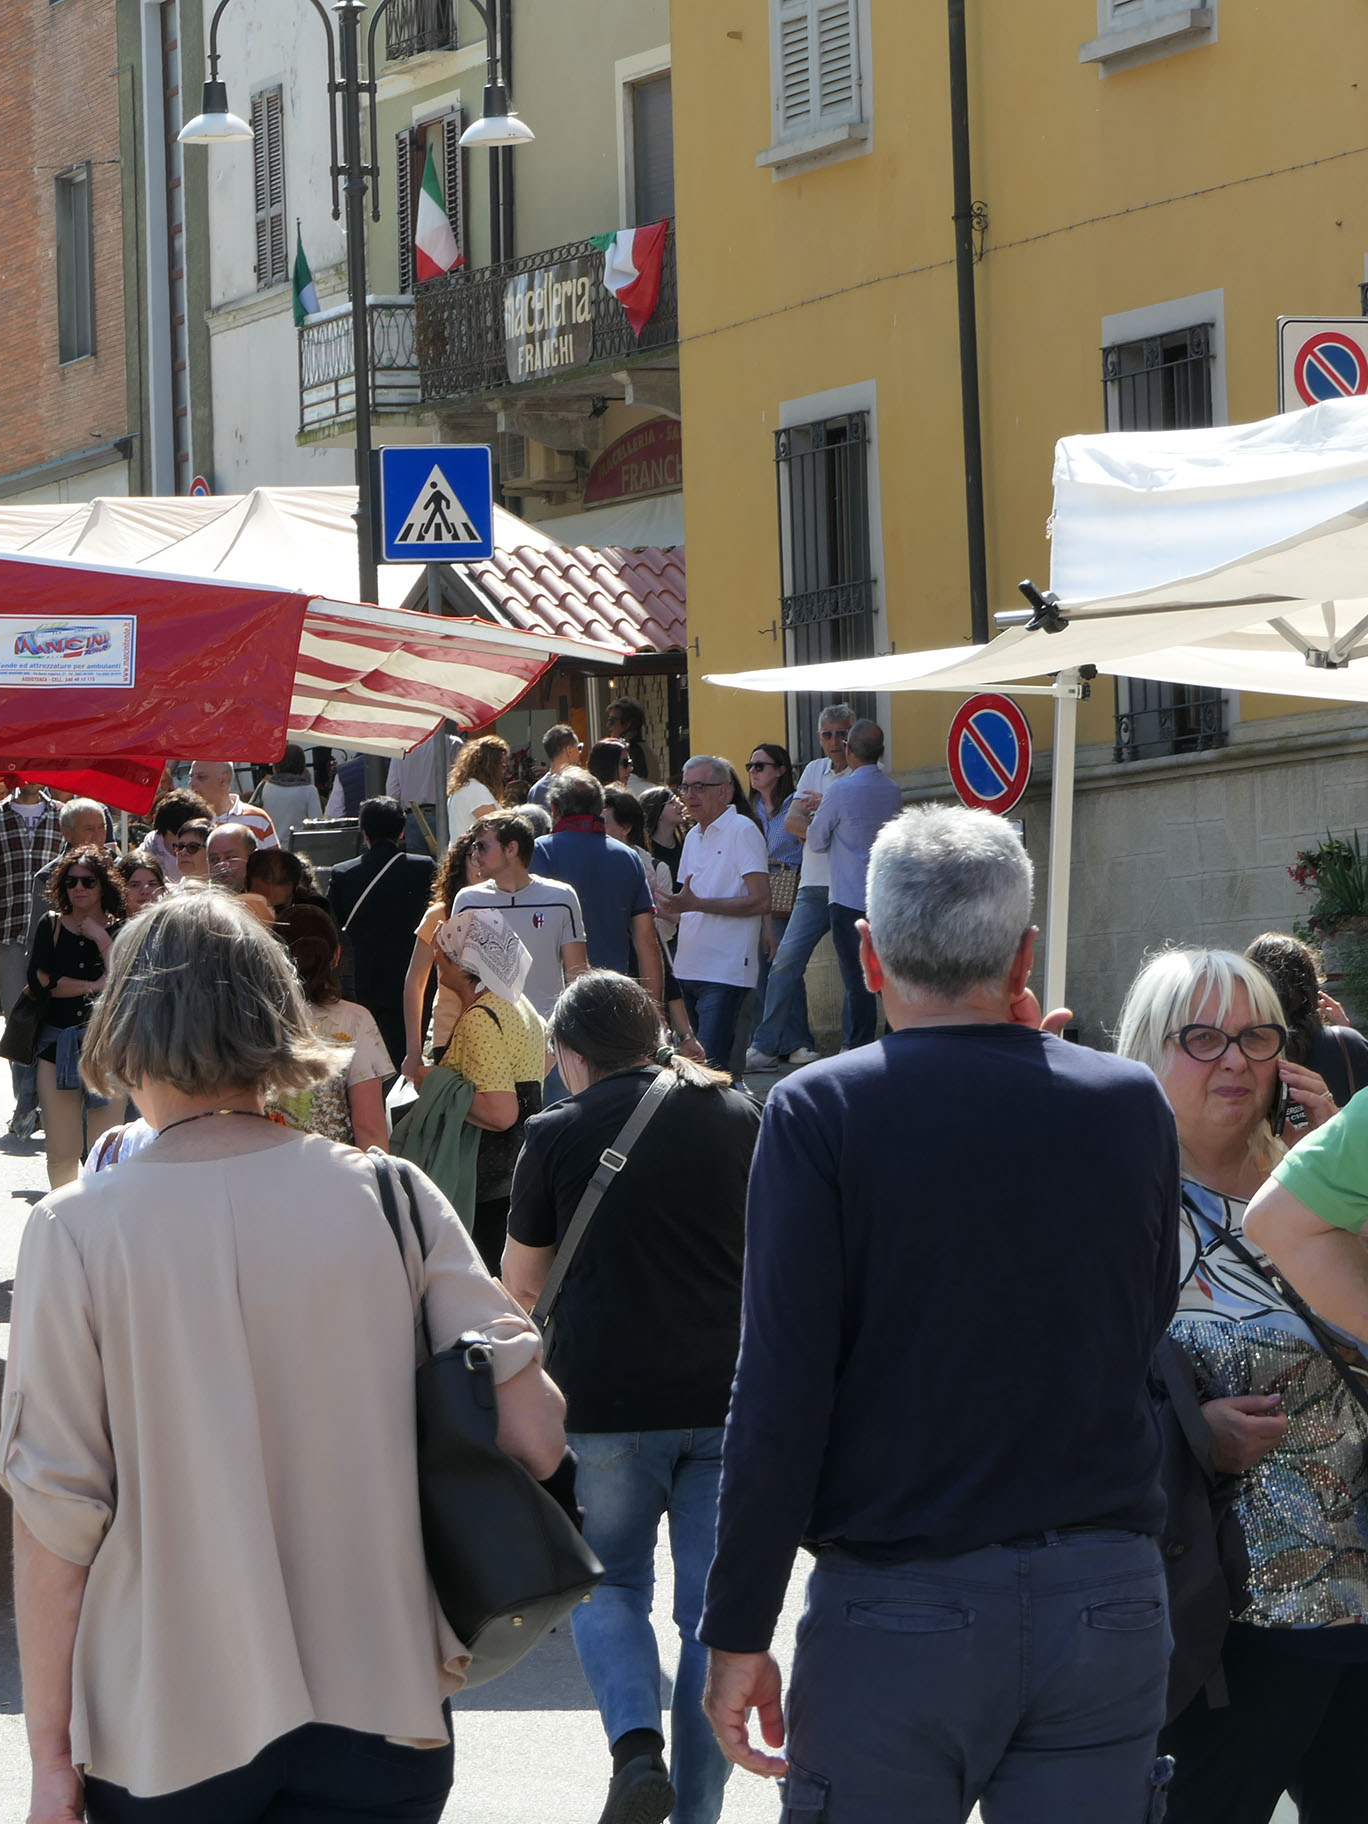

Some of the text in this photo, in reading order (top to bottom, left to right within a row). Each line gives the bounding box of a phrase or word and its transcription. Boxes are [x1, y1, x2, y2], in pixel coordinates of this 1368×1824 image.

[504, 272, 592, 340] macelleria
[518, 334, 574, 376] FRANCHI
[598, 429, 656, 480] MACELLERIA
